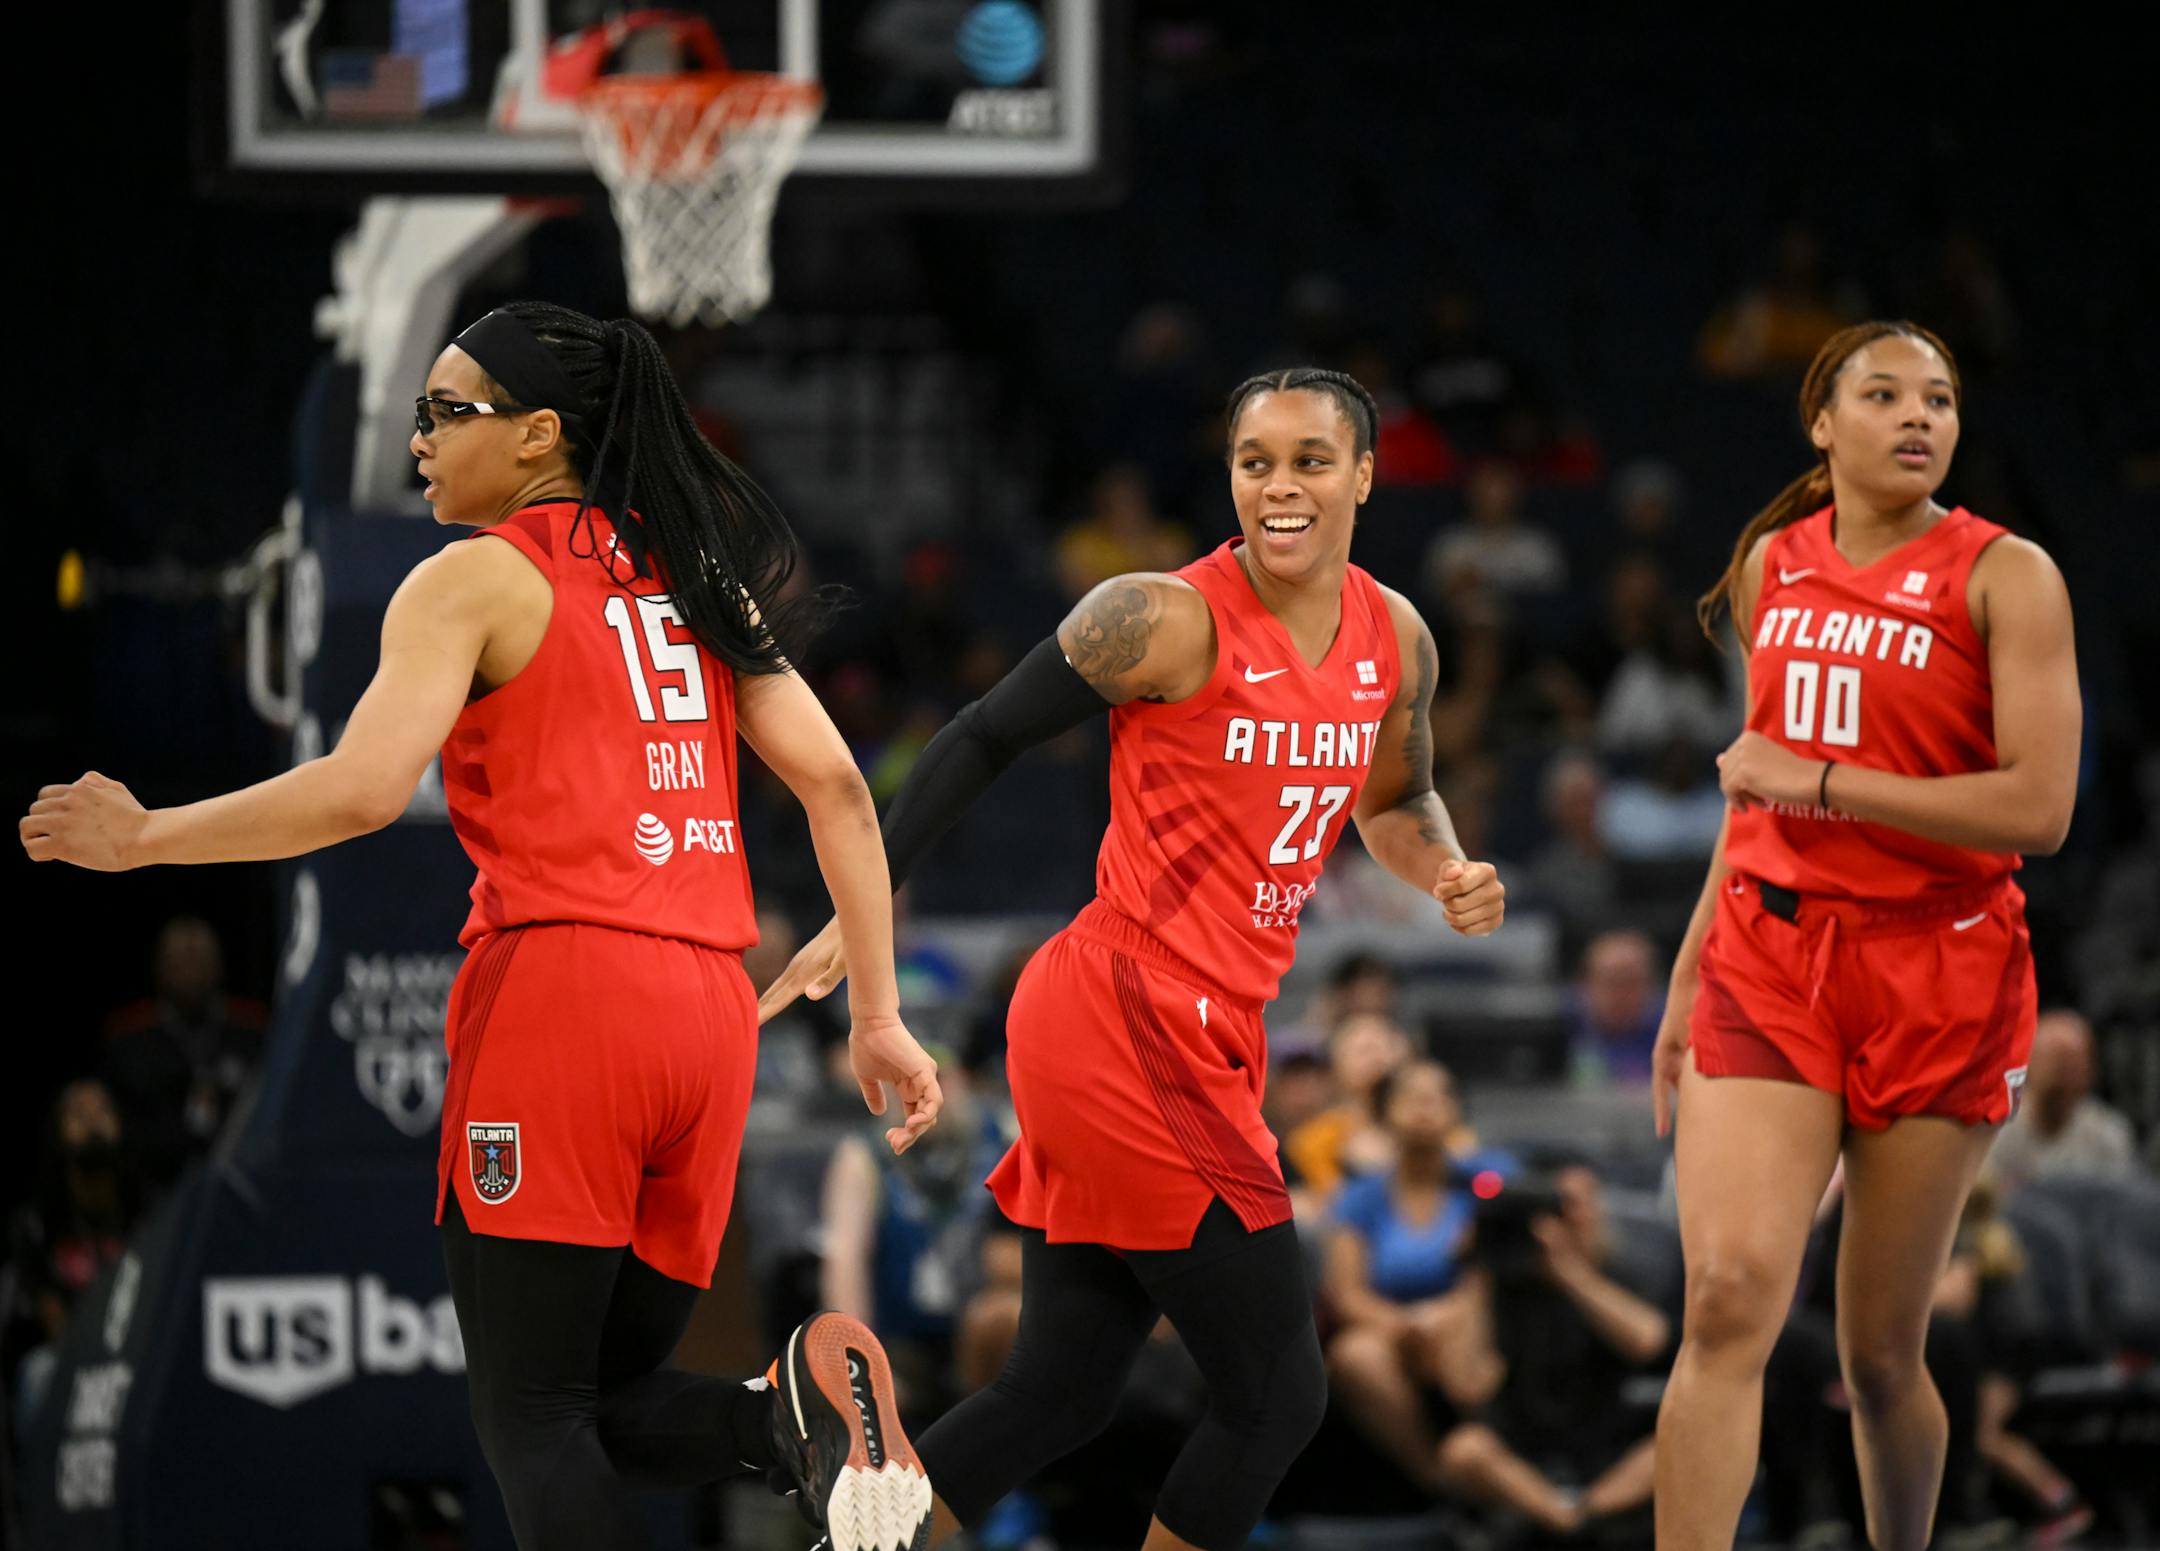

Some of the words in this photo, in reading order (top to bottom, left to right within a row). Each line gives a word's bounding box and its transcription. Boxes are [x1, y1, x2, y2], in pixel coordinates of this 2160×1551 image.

[603, 595, 708, 722] 15
[1755, 608, 1933, 670] ATLANTA
[1784, 660, 1862, 748] 00
[646, 741, 705, 791] GRAY
[684, 817, 735, 854] AT&T
[470, 1128, 514, 1141] ATLANTA
[225, 1303, 331, 1368] us
